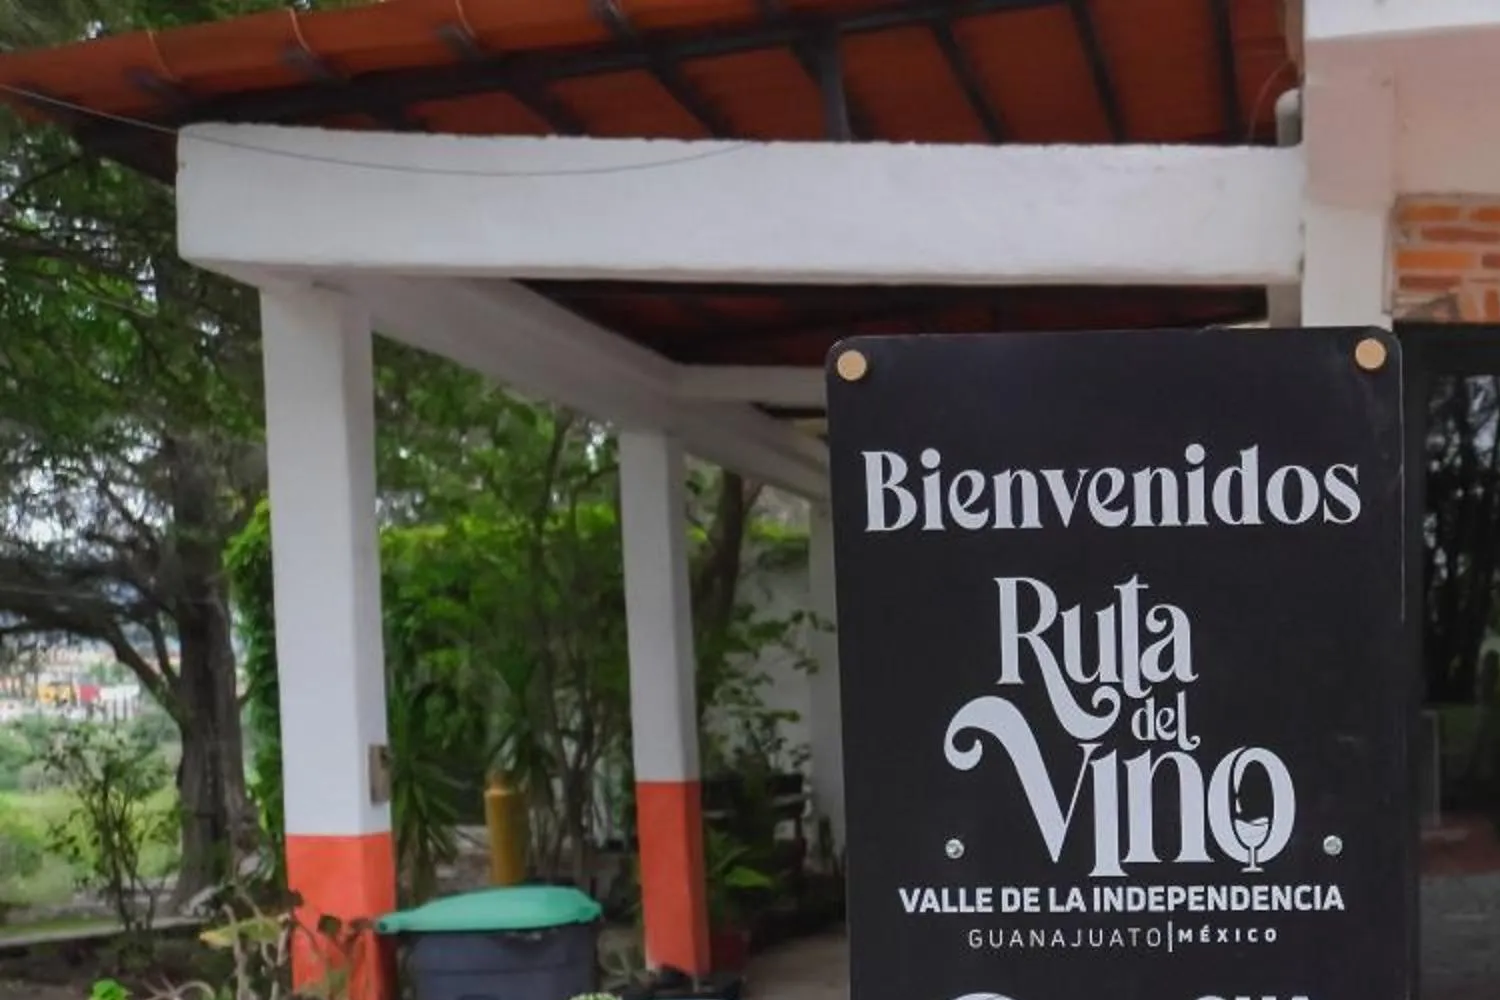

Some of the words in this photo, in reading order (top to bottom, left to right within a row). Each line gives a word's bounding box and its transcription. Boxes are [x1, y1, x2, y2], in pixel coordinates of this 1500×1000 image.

[861, 443, 1361, 532] Bienvenidos
[993, 574, 1199, 740] Ruta
[1131, 691, 1200, 750] del
[943, 695, 1296, 877] Vino
[898, 887, 994, 913] VALLE
[1001, 887, 1041, 913] DE
[1047, 886, 1089, 912] LA
[1093, 884, 1345, 912] INDEPENDENCIA
[968, 927, 1162, 949] GUANAJUATO
[1177, 924, 1278, 944] MÉXICO
